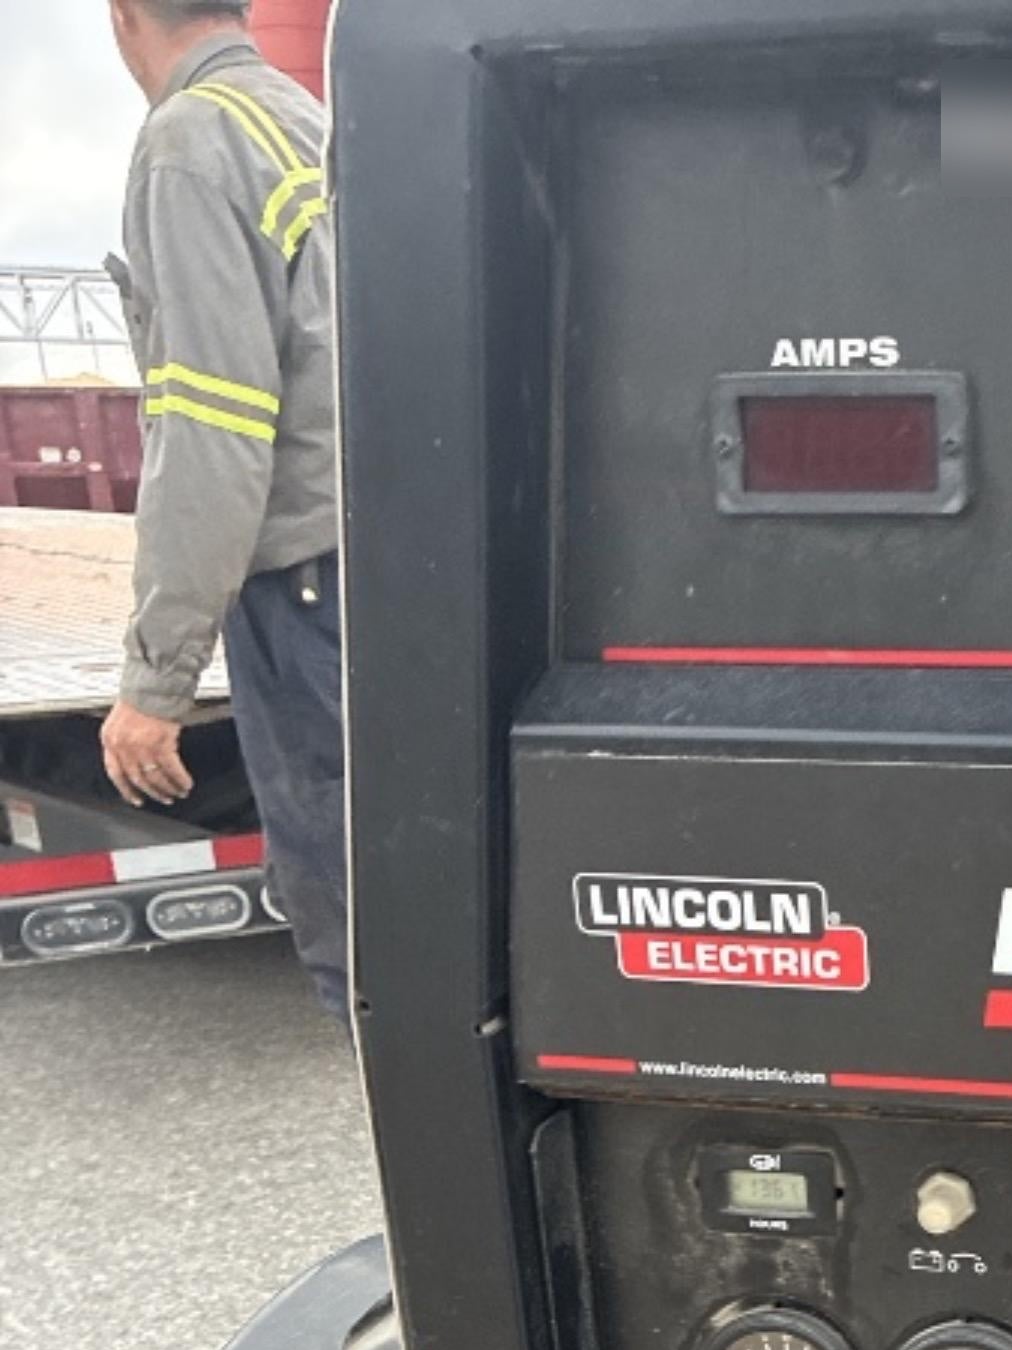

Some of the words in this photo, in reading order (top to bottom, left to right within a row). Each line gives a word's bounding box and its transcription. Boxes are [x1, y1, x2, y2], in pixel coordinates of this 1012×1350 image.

[771, 336, 901, 368] AMPS
[589, 884, 812, 935] LINCOLN
[647, 941, 841, 980] ELECTRIC
[639, 1060, 827, 1085] www.lincolnelectric.com
